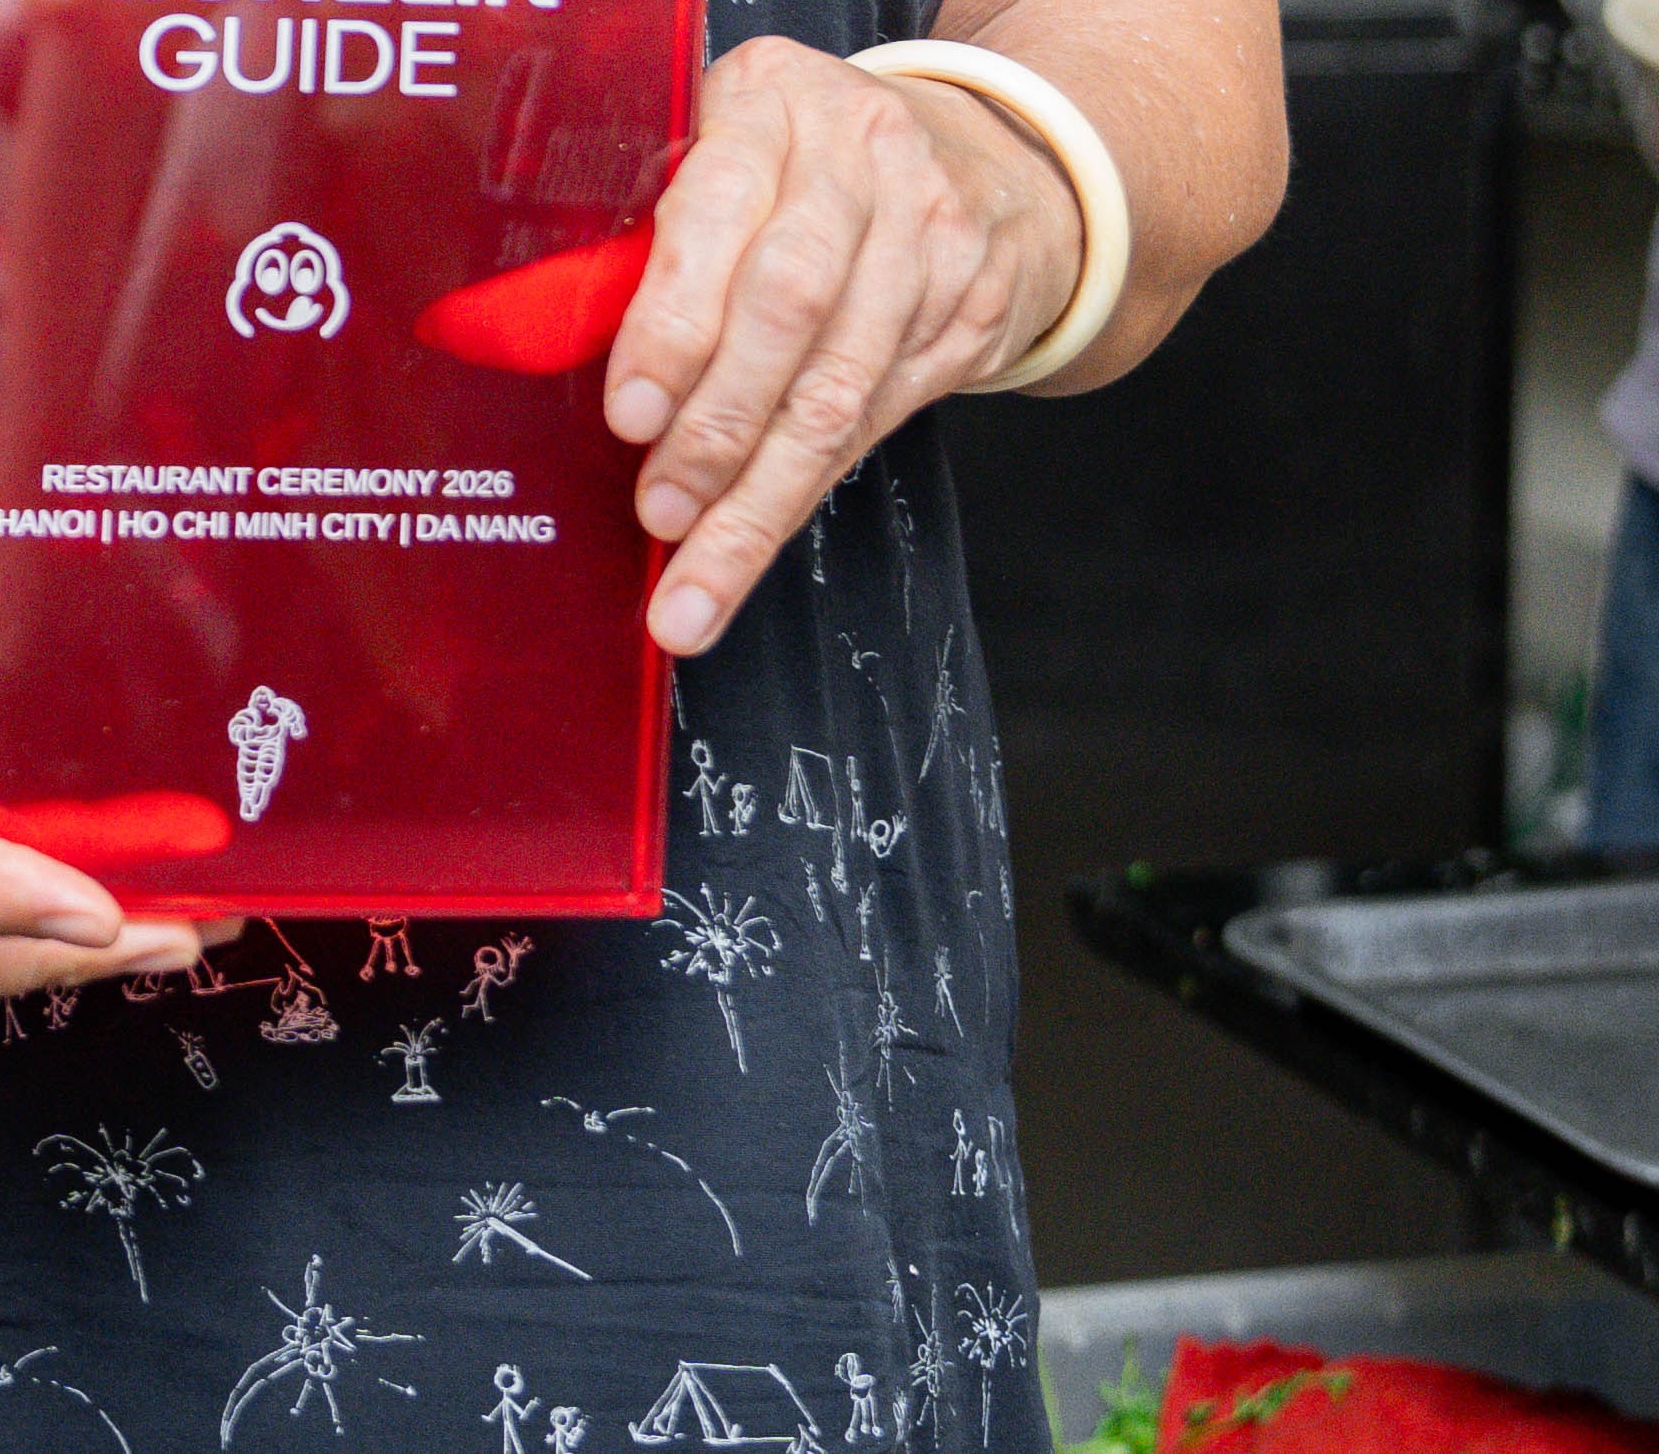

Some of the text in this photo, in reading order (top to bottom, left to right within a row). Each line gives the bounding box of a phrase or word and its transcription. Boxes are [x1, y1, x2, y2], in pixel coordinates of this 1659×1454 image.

[138, 13, 461, 97] GUIDE
[41, 463, 516, 499] RESTAURANT CEREMONY 2026
[117, 509, 169, 539] HO
[172, 510, 230, 540] CHI
[234, 511, 317, 541] MINH
[321, 512, 397, 541] CITY
[416, 513, 463, 543] DA
[465, 514, 557, 544] NANG
